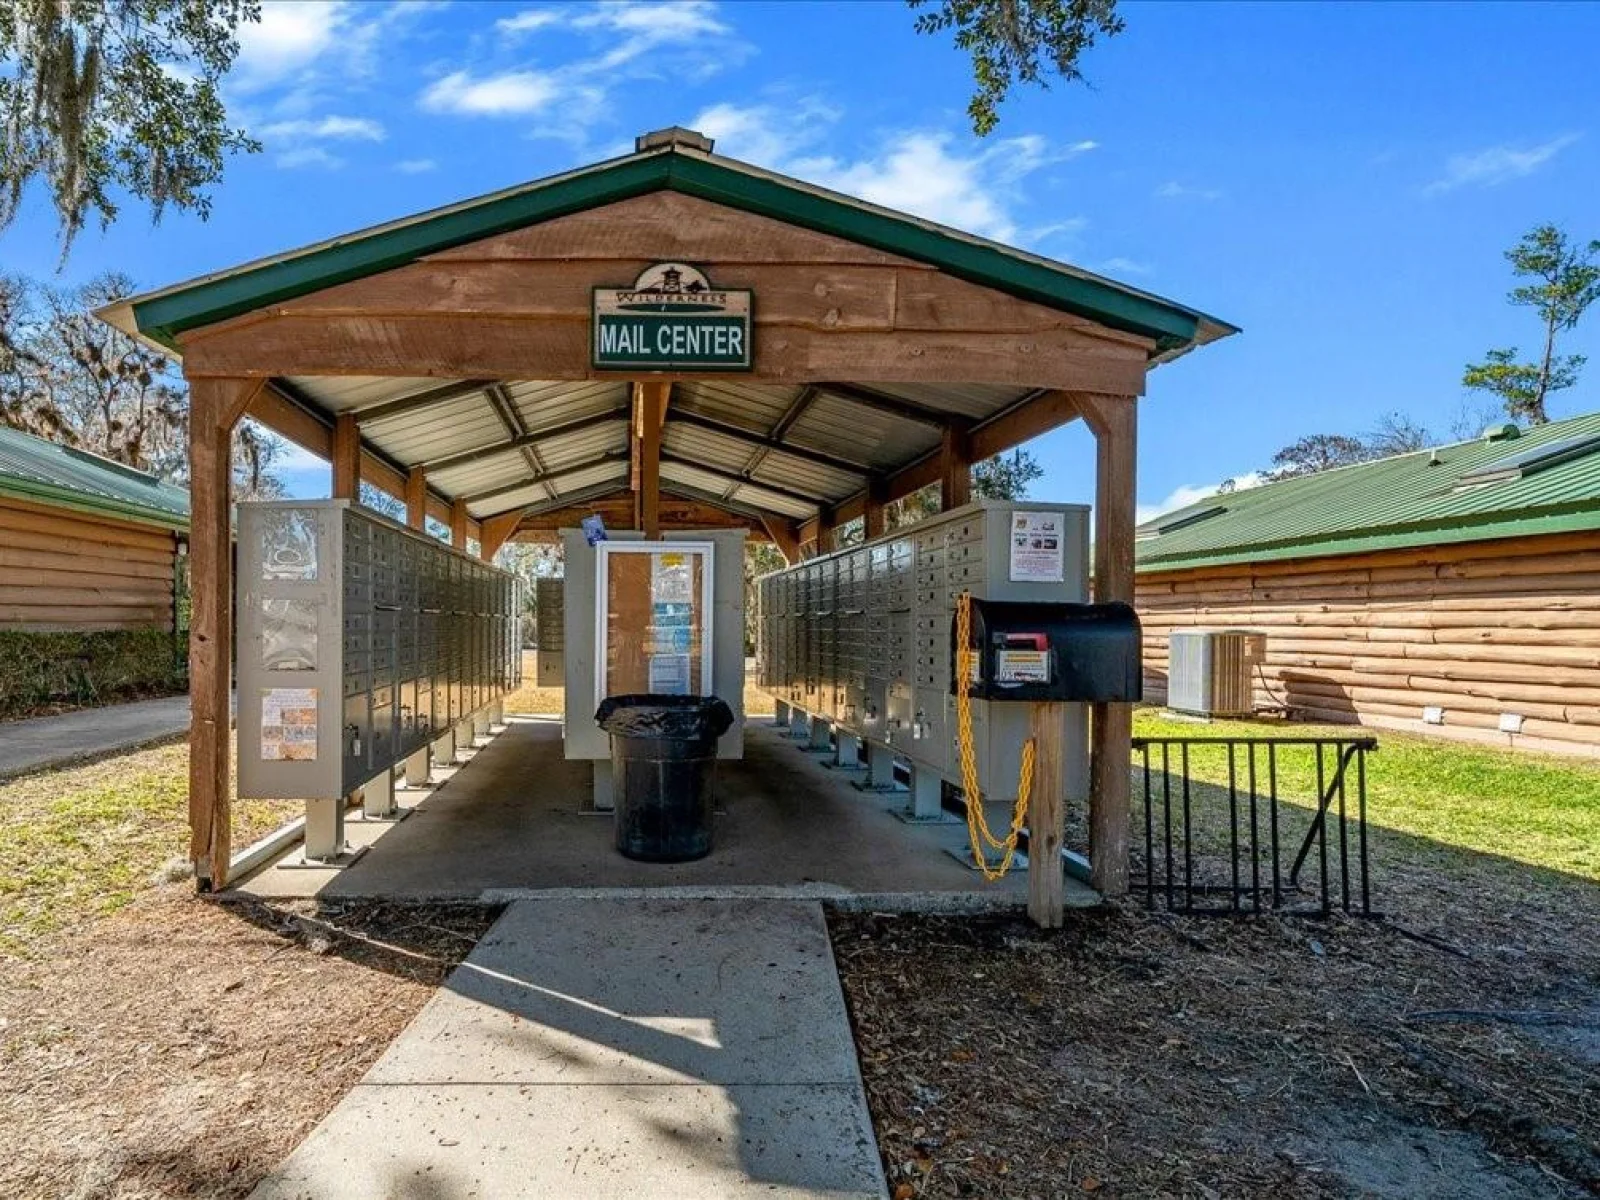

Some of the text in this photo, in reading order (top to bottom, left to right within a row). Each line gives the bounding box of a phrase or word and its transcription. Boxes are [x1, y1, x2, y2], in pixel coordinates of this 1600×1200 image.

[616, 292, 727, 304] WILDERNESS
[600, 324, 743, 355] MAIL CENTER
